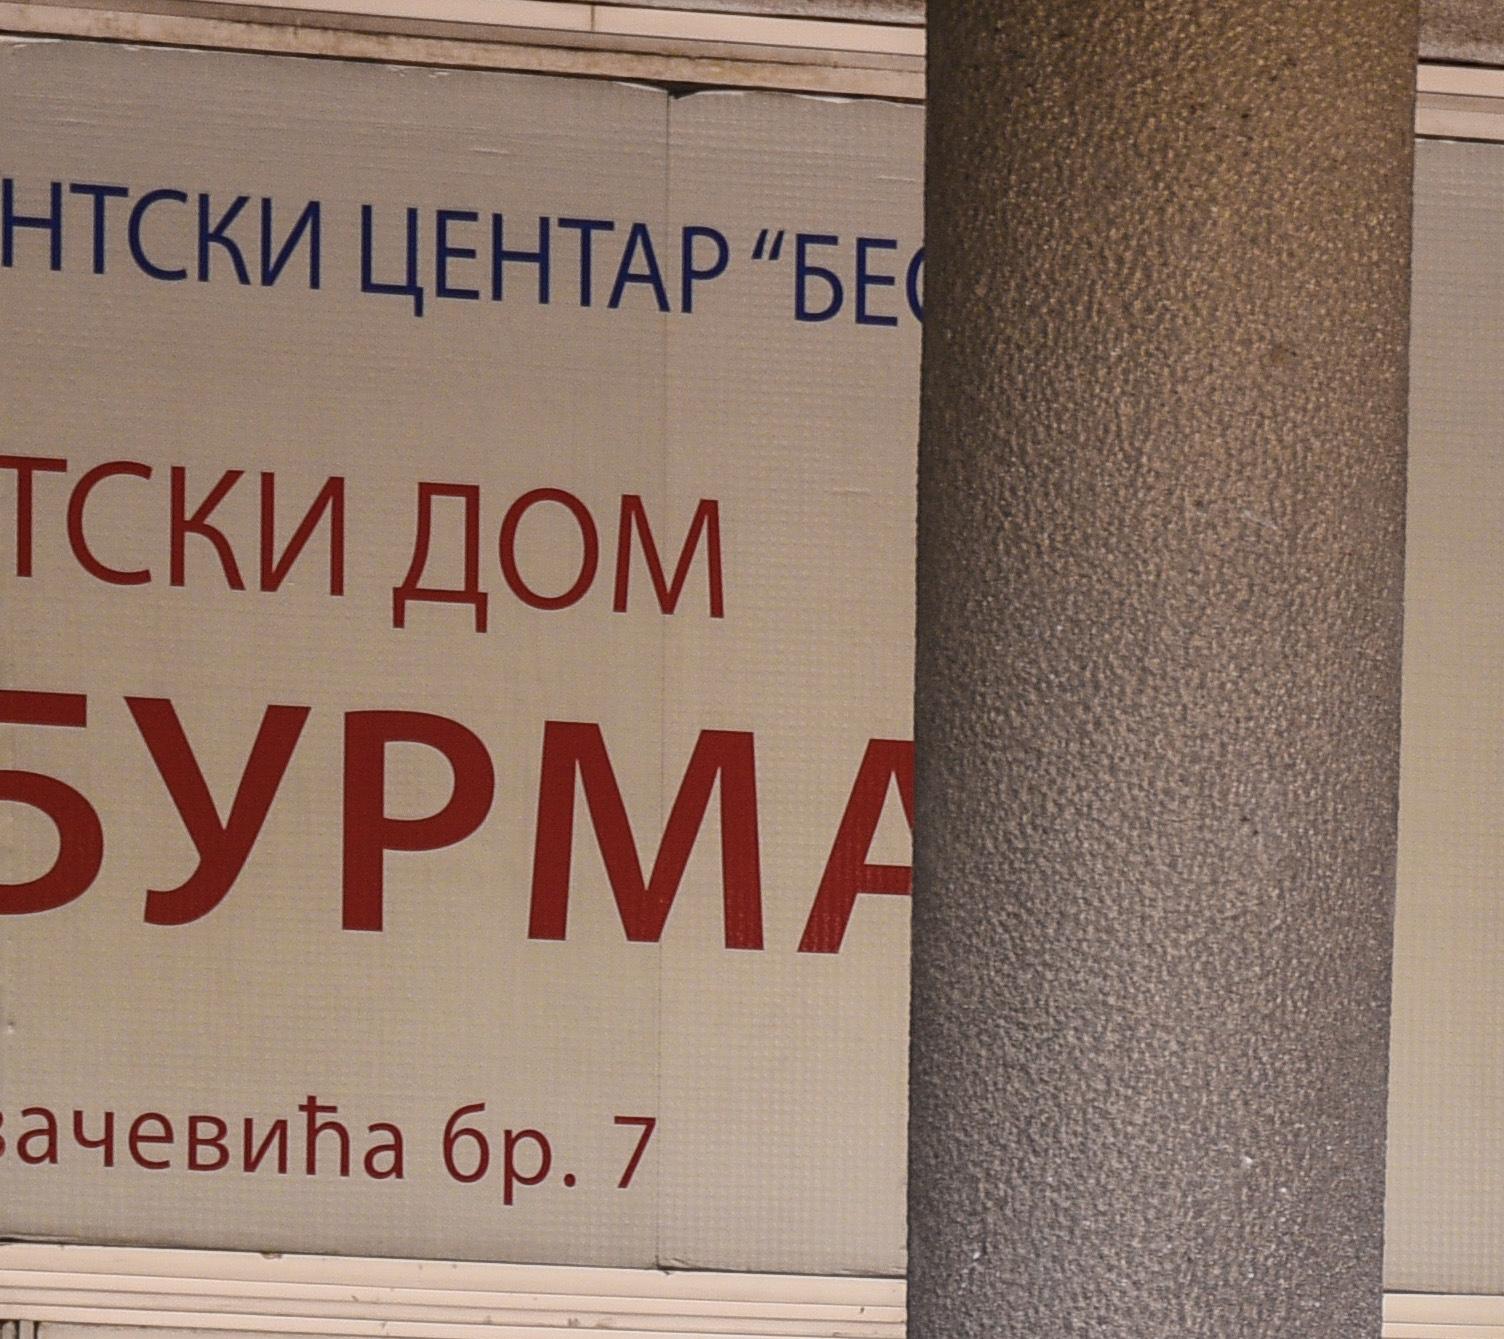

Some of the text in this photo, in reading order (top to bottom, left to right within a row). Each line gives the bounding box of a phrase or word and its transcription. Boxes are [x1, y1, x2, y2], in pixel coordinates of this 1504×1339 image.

[360, 203, 730, 317] ЦЕНТАР
[751, 227, 926, 327] “БЕ
[391, 480, 727, 634] ДОМ
[442, 1102, 578, 1205] бр.
[614, 1114, 658, 1189] 7
